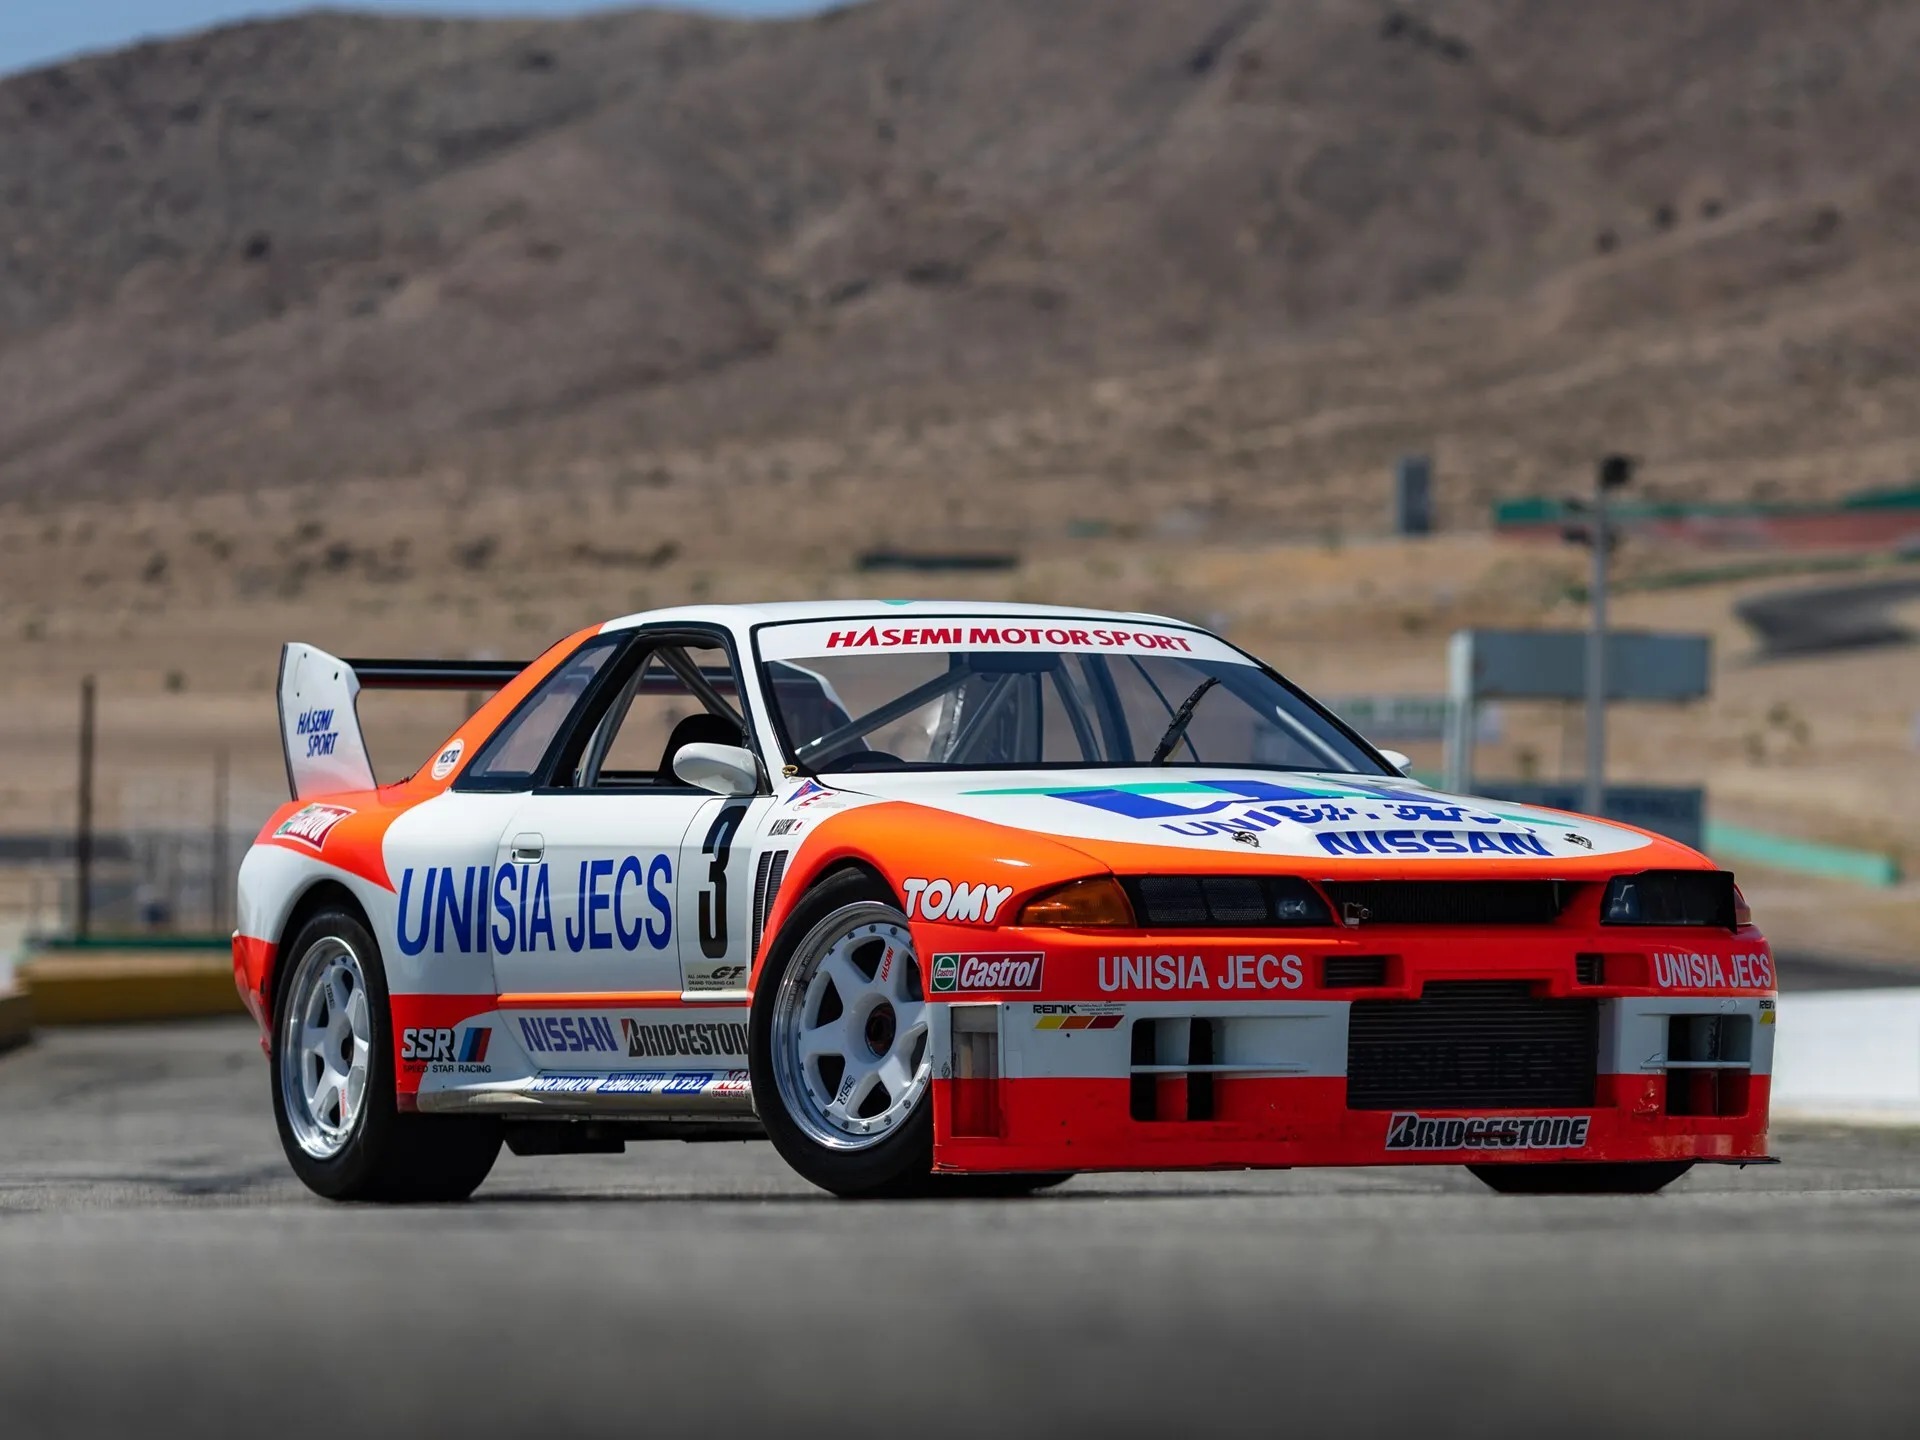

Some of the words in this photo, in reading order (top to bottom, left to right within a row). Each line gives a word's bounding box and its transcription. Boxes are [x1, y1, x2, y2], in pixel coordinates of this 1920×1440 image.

[826, 626, 962, 648] HASEMI
[297, 706, 334, 734] HASEMI
[307, 732, 338, 757] SPORT
[287, 807, 347, 842] Castrol
[1314, 830, 1555, 856] NISSAN
[699, 804, 748, 959] 3
[397, 863, 556, 956] UNISIA
[566, 854, 673, 952] JECS
[902, 877, 1013, 923] TOMY
[881, 946, 894, 982] HASEMI
[960, 957, 1040, 988] Castrol
[1098, 955, 1209, 991] UNISIA
[1217, 954, 1303, 990] JECS
[1654, 953, 1726, 988] UNISIA
[1729, 953, 1771, 988] JECS
[401, 1029, 454, 1061] SSR
[518, 1017, 619, 1052] NISSAN
[621, 1018, 749, 1057] BRIDGESTON
[403, 1065, 428, 1073] SPEED
[432, 1064, 454, 1073] STAR
[458, 1064, 492, 1073] RACING
[837, 1074, 856, 1105] SSR
[1388, 1112, 1590, 1150] BRIDGESTONE
